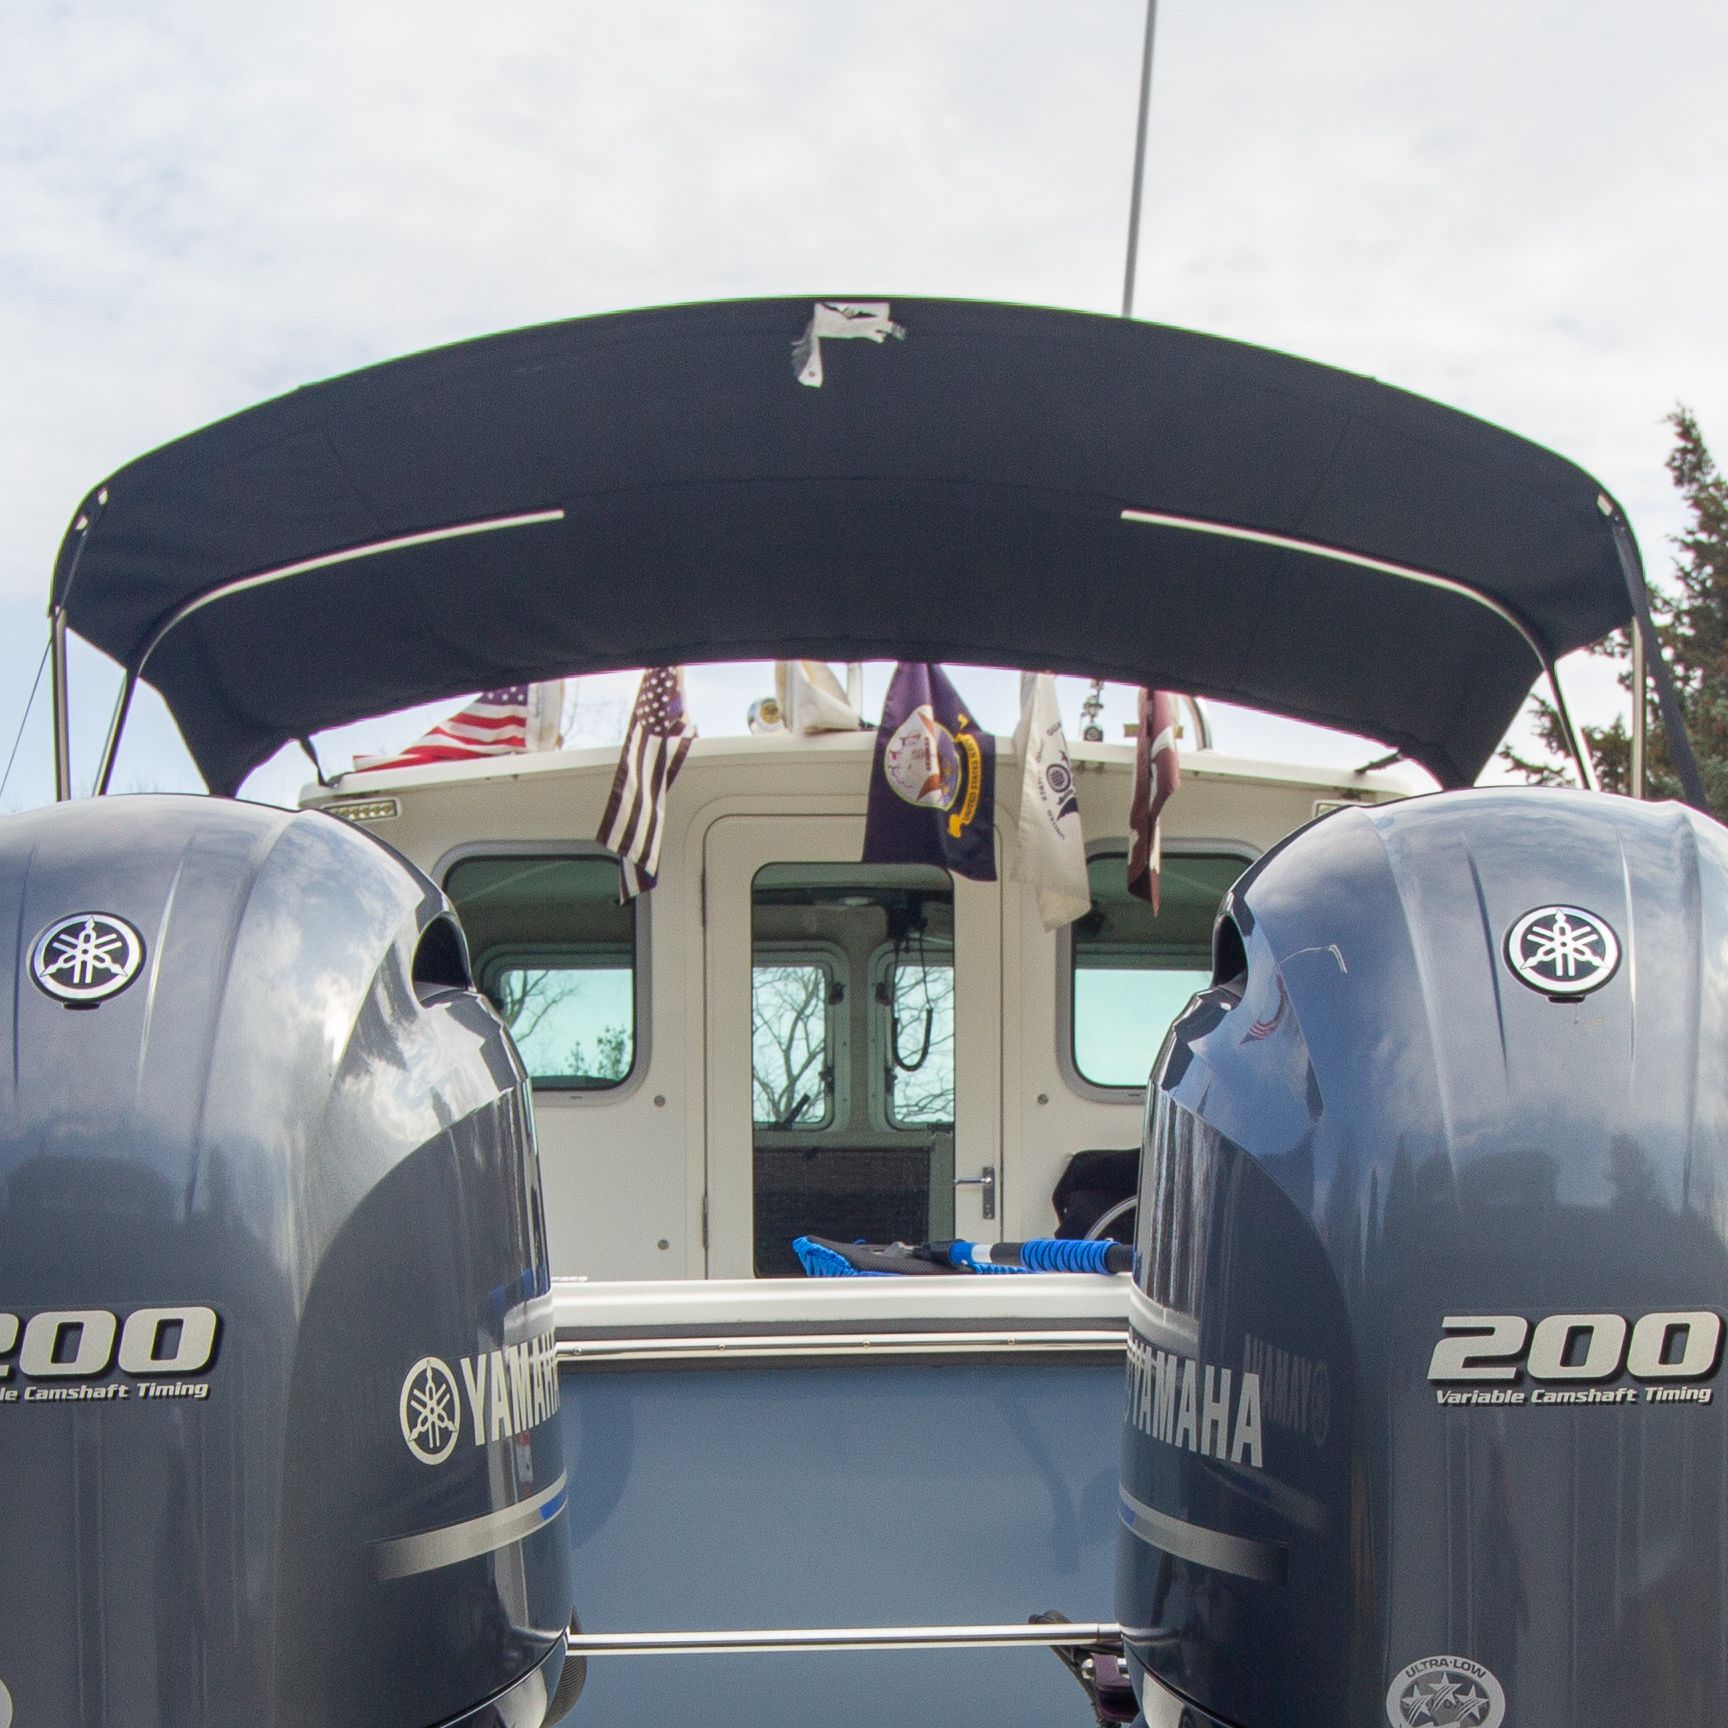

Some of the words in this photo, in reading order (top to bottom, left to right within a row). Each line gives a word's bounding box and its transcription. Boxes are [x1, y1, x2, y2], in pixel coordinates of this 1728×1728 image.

[1427, 1311, 1721, 1381] 200
[24, 1384, 129, 1401] Camshaft
[137, 1382, 209, 1399] Timing
[1436, 1389, 1525, 1404] Variable
[1531, 1388, 1637, 1403] Camshaft
[1644, 1386, 1712, 1403] Timing
